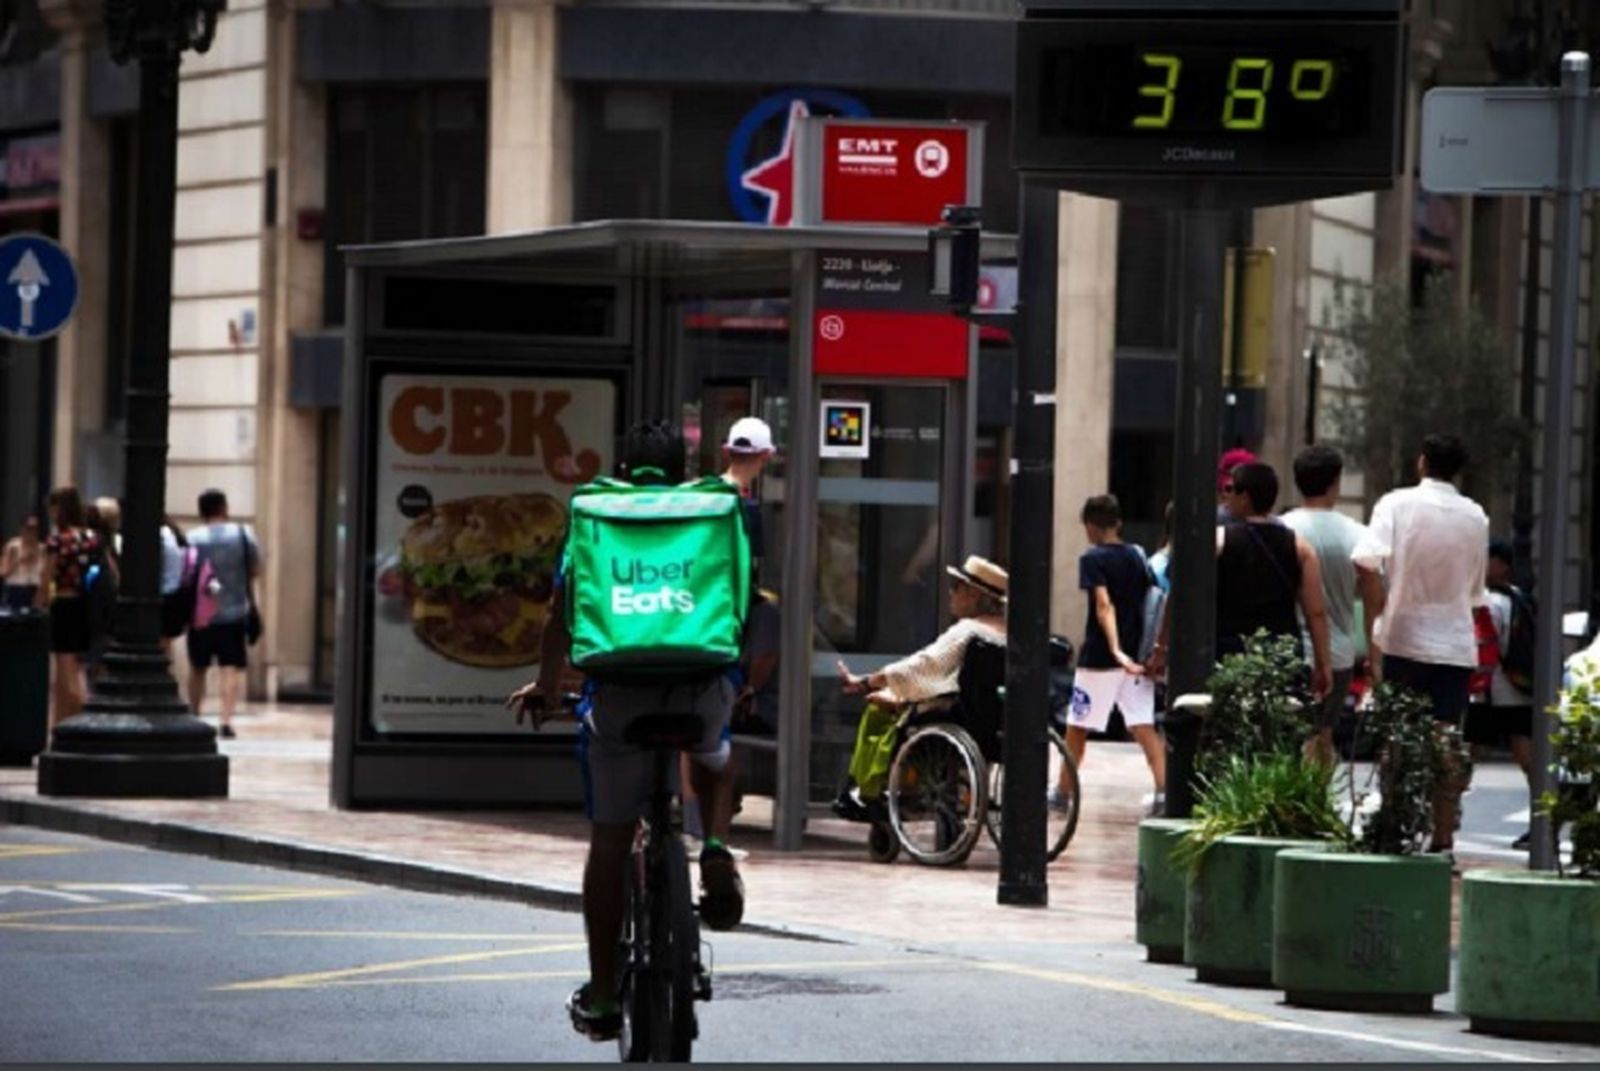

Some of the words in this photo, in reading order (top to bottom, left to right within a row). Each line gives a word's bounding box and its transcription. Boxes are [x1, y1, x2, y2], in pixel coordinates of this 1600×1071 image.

[838, 137, 899, 153] EMT
[388, 386, 601, 485] CBK
[610, 557, 695, 585] Uber
[611, 584, 695, 615] Eats
